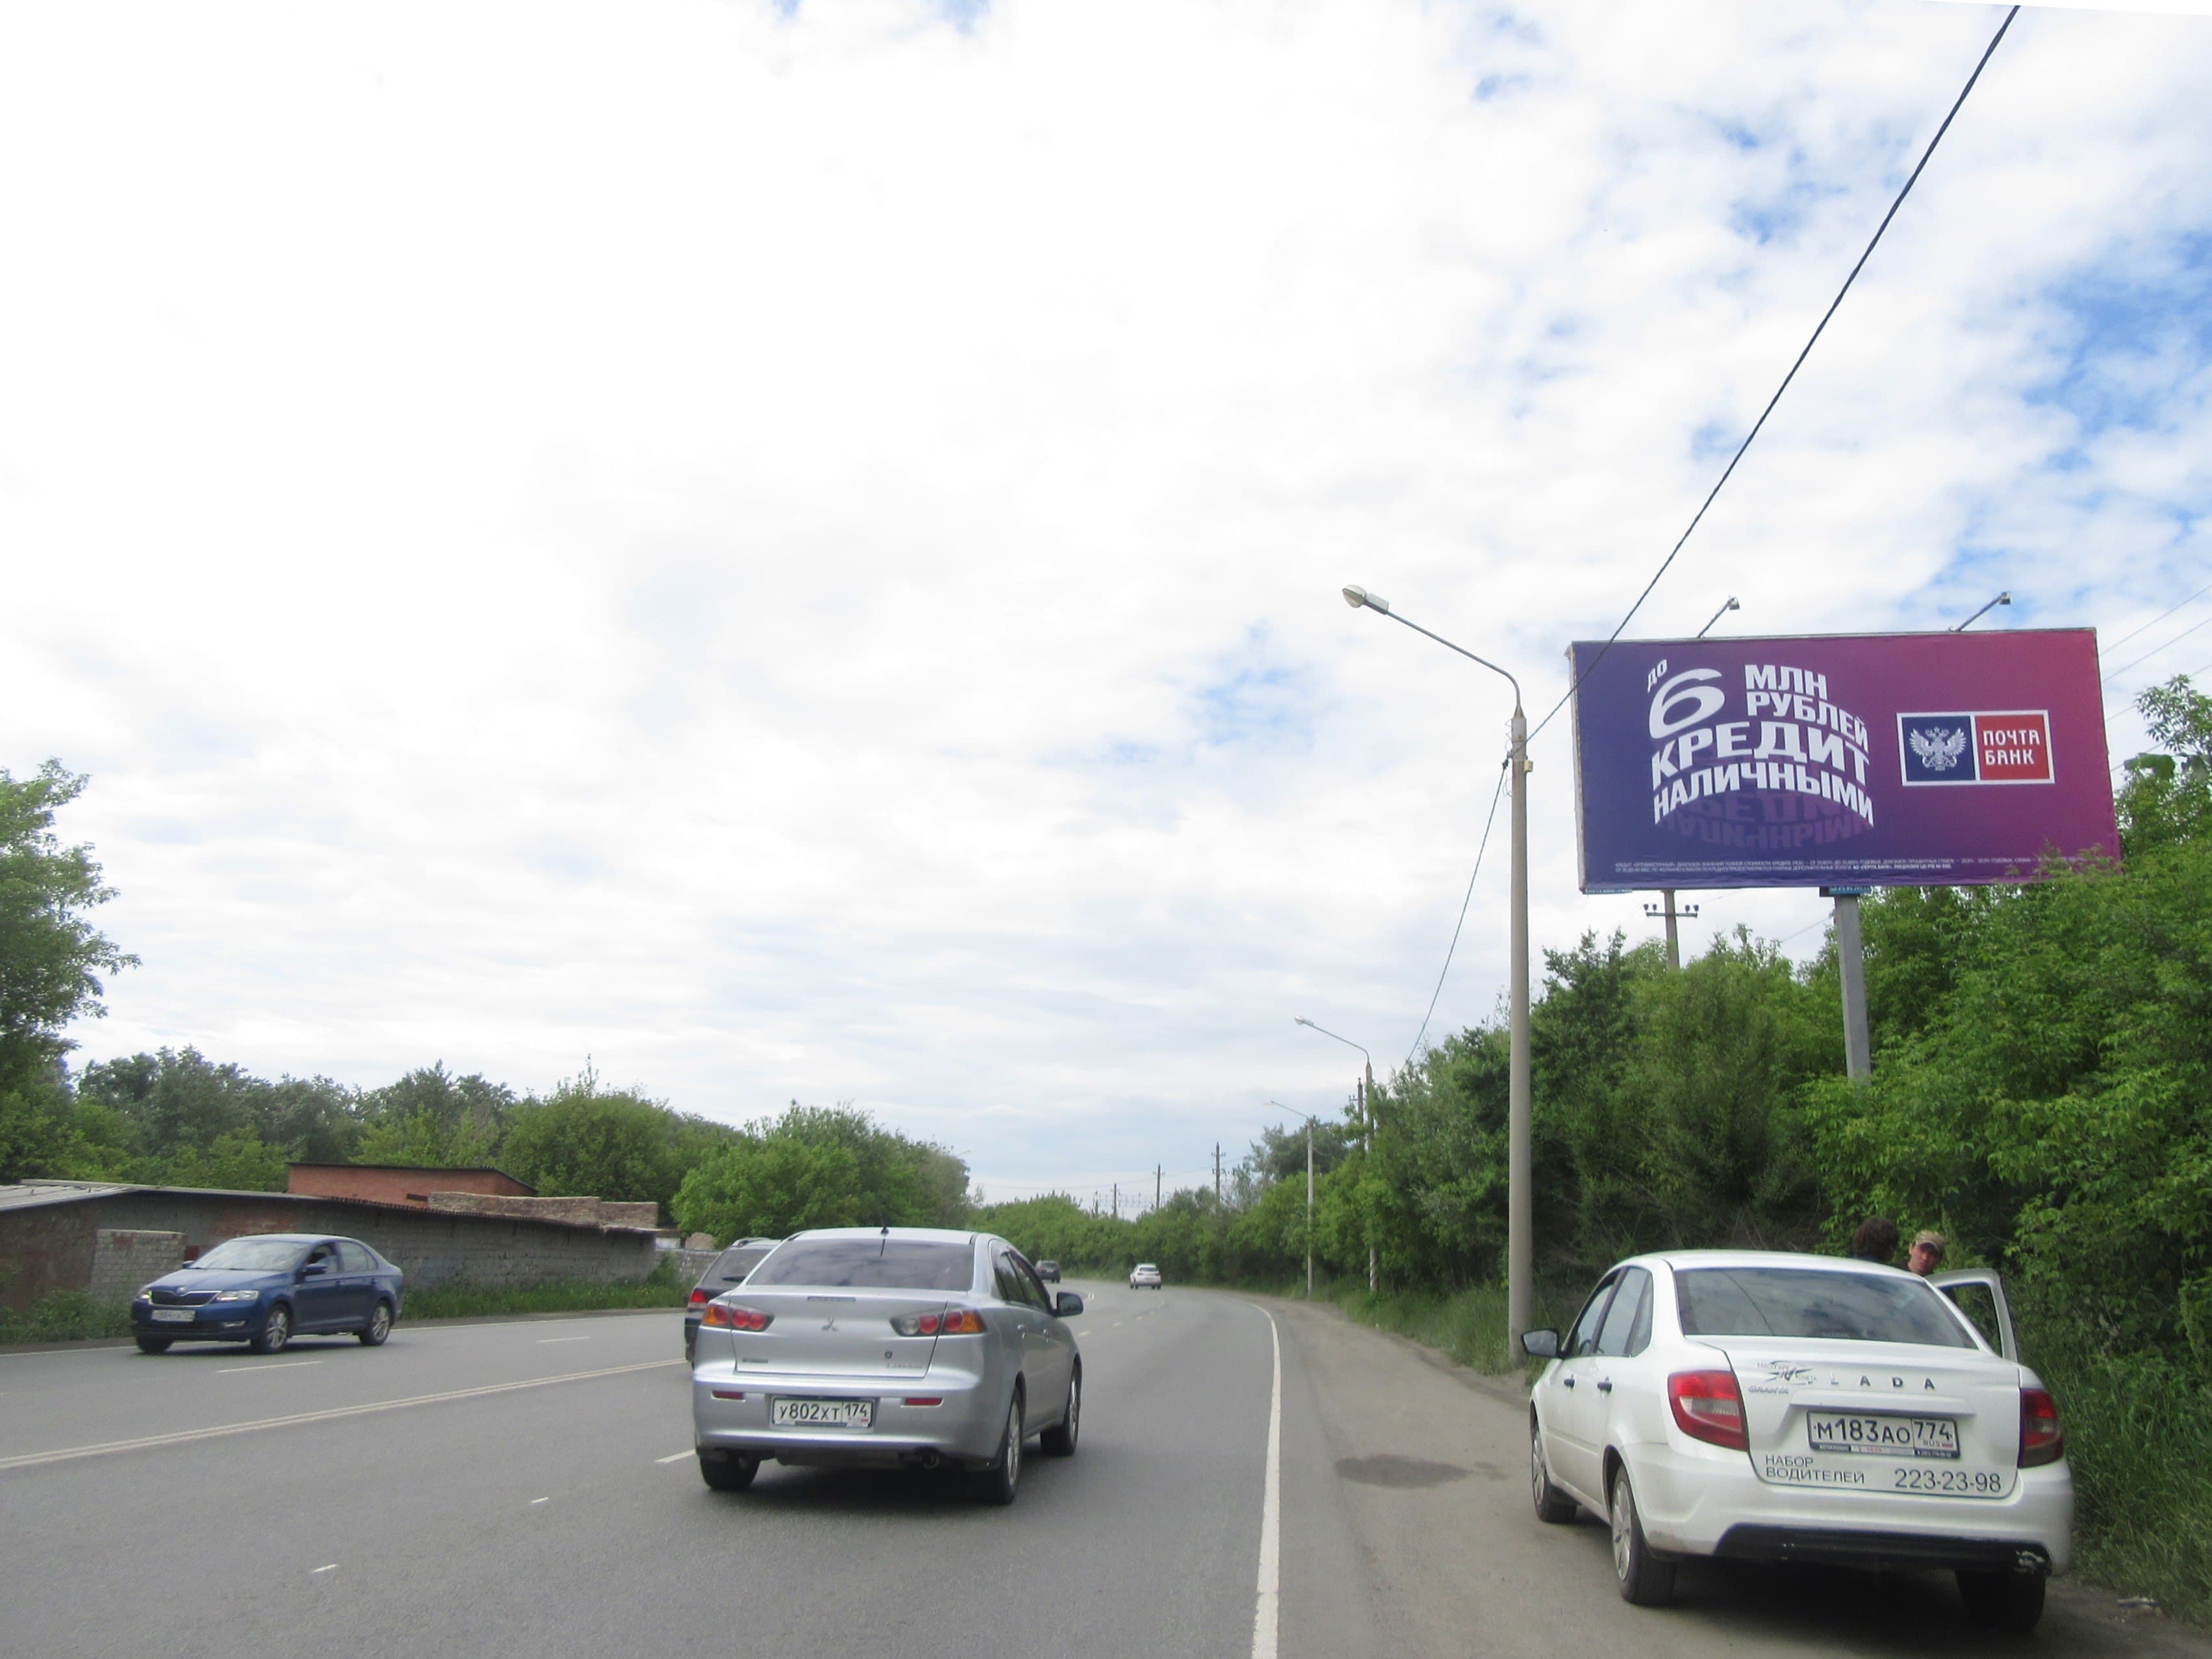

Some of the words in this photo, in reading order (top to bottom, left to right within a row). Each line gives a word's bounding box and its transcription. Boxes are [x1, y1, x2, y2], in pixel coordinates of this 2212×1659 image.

[1647, 659, 1668, 692] ДО
[1745, 665, 1828, 700] МЛН
[1649, 668, 1725, 739] 6
[1746, 691, 1868, 754] РУБЛЕЙ
[1983, 729, 2040, 746] ПОЧТА
[1651, 721, 1870, 791] КРЕДИТ
[1985, 749, 2035, 765] БАНК
[1653, 762, 1874, 827] НАЛИЧНЫМИ
[1829, 1373, 1935, 1390] LADA
[1914, 1421, 1950, 1440] 774
[1765, 1454, 1814, 1467] НАБОР
[1766, 1466, 1865, 1484] ВОДИТЕЛЕЙ
[1894, 1468, 2002, 1493] 223-23-98
